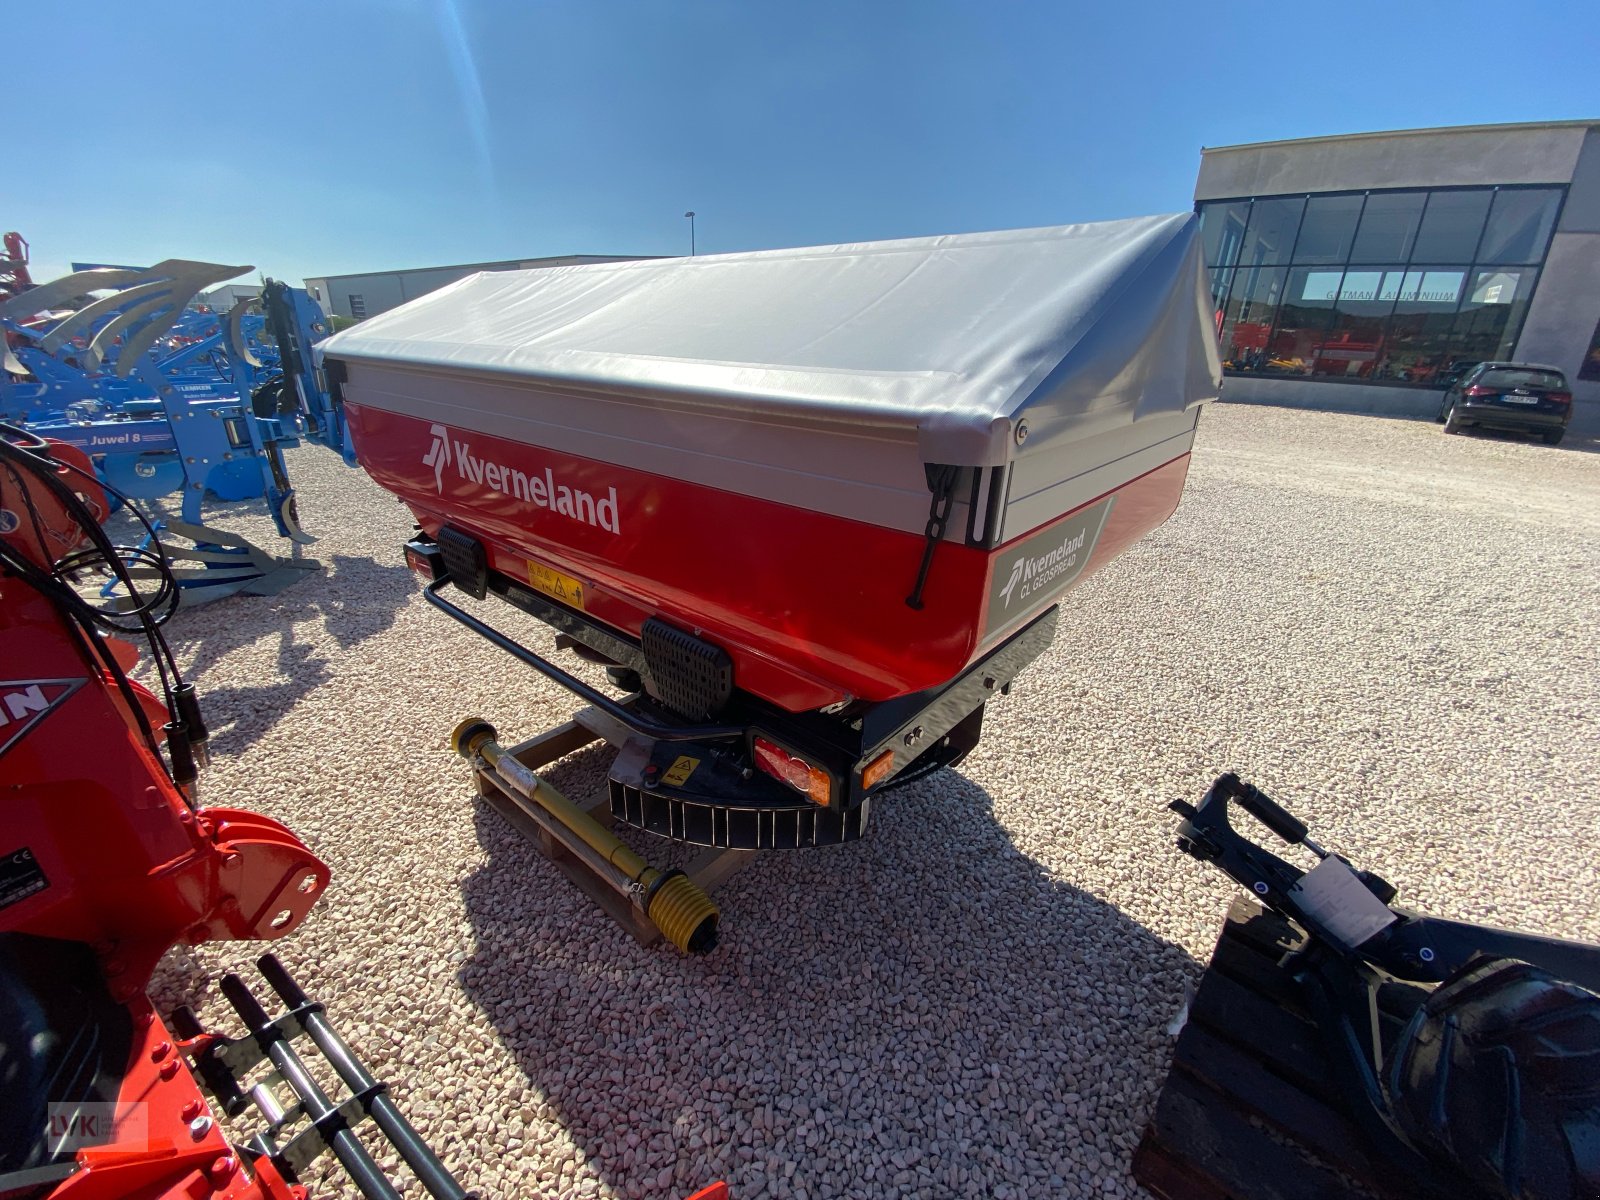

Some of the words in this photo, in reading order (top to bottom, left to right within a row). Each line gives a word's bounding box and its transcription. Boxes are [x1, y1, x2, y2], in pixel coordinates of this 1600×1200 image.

[1384, 291, 1454, 301] ALMNIUM
[90, 433, 129, 446] Juwel
[132, 433, 141, 443] 8
[454, 440, 621, 535] Kverneland
[1020, 582, 1031, 599] CL
[1032, 553, 1076, 591] GEOSPREAD
[1023, 527, 1086, 583] Kverneland
